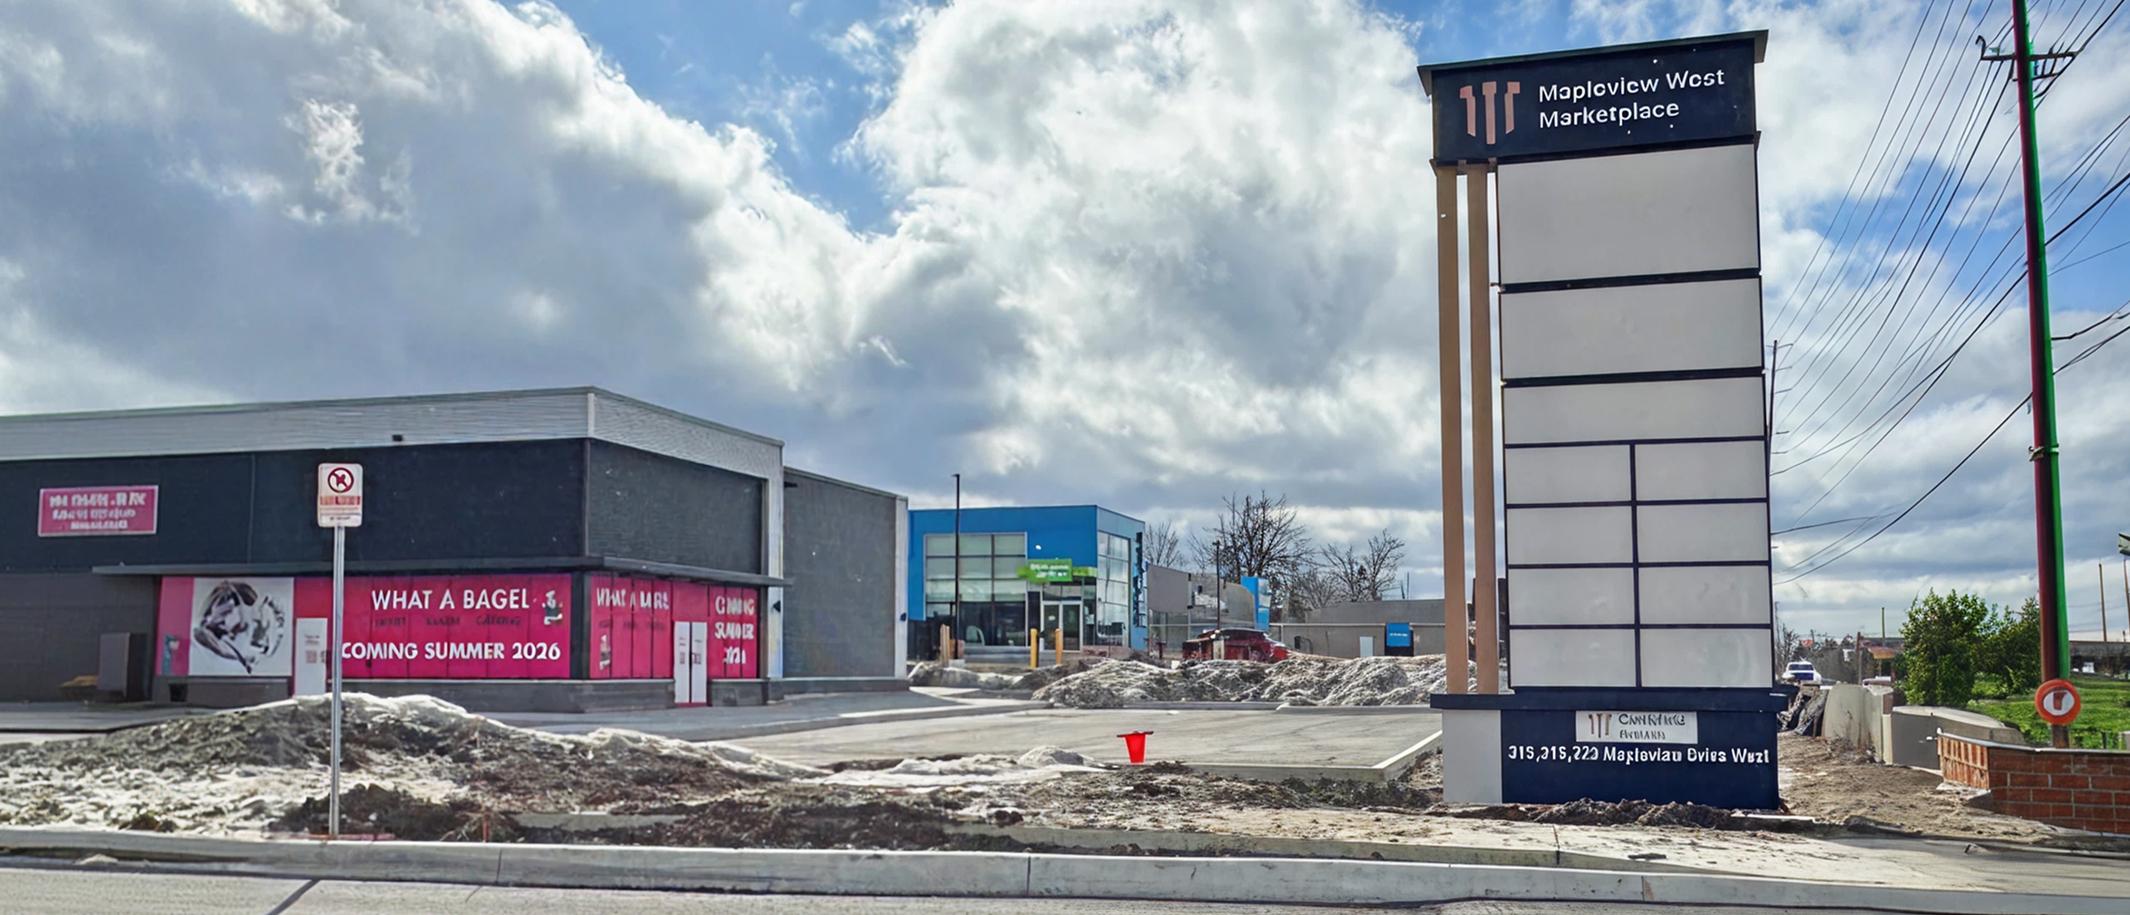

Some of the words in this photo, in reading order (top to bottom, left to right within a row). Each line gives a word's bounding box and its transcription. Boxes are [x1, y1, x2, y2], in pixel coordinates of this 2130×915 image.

[1539, 102, 1680, 128] Marketplace
[371, 589, 433, 611] WHAT
[438, 588, 456, 610] A
[462, 588, 530, 610] BAGEL
[341, 642, 418, 661] COMING
[424, 642, 505, 660] SUMMER
[511, 642, 562, 661] 2026
